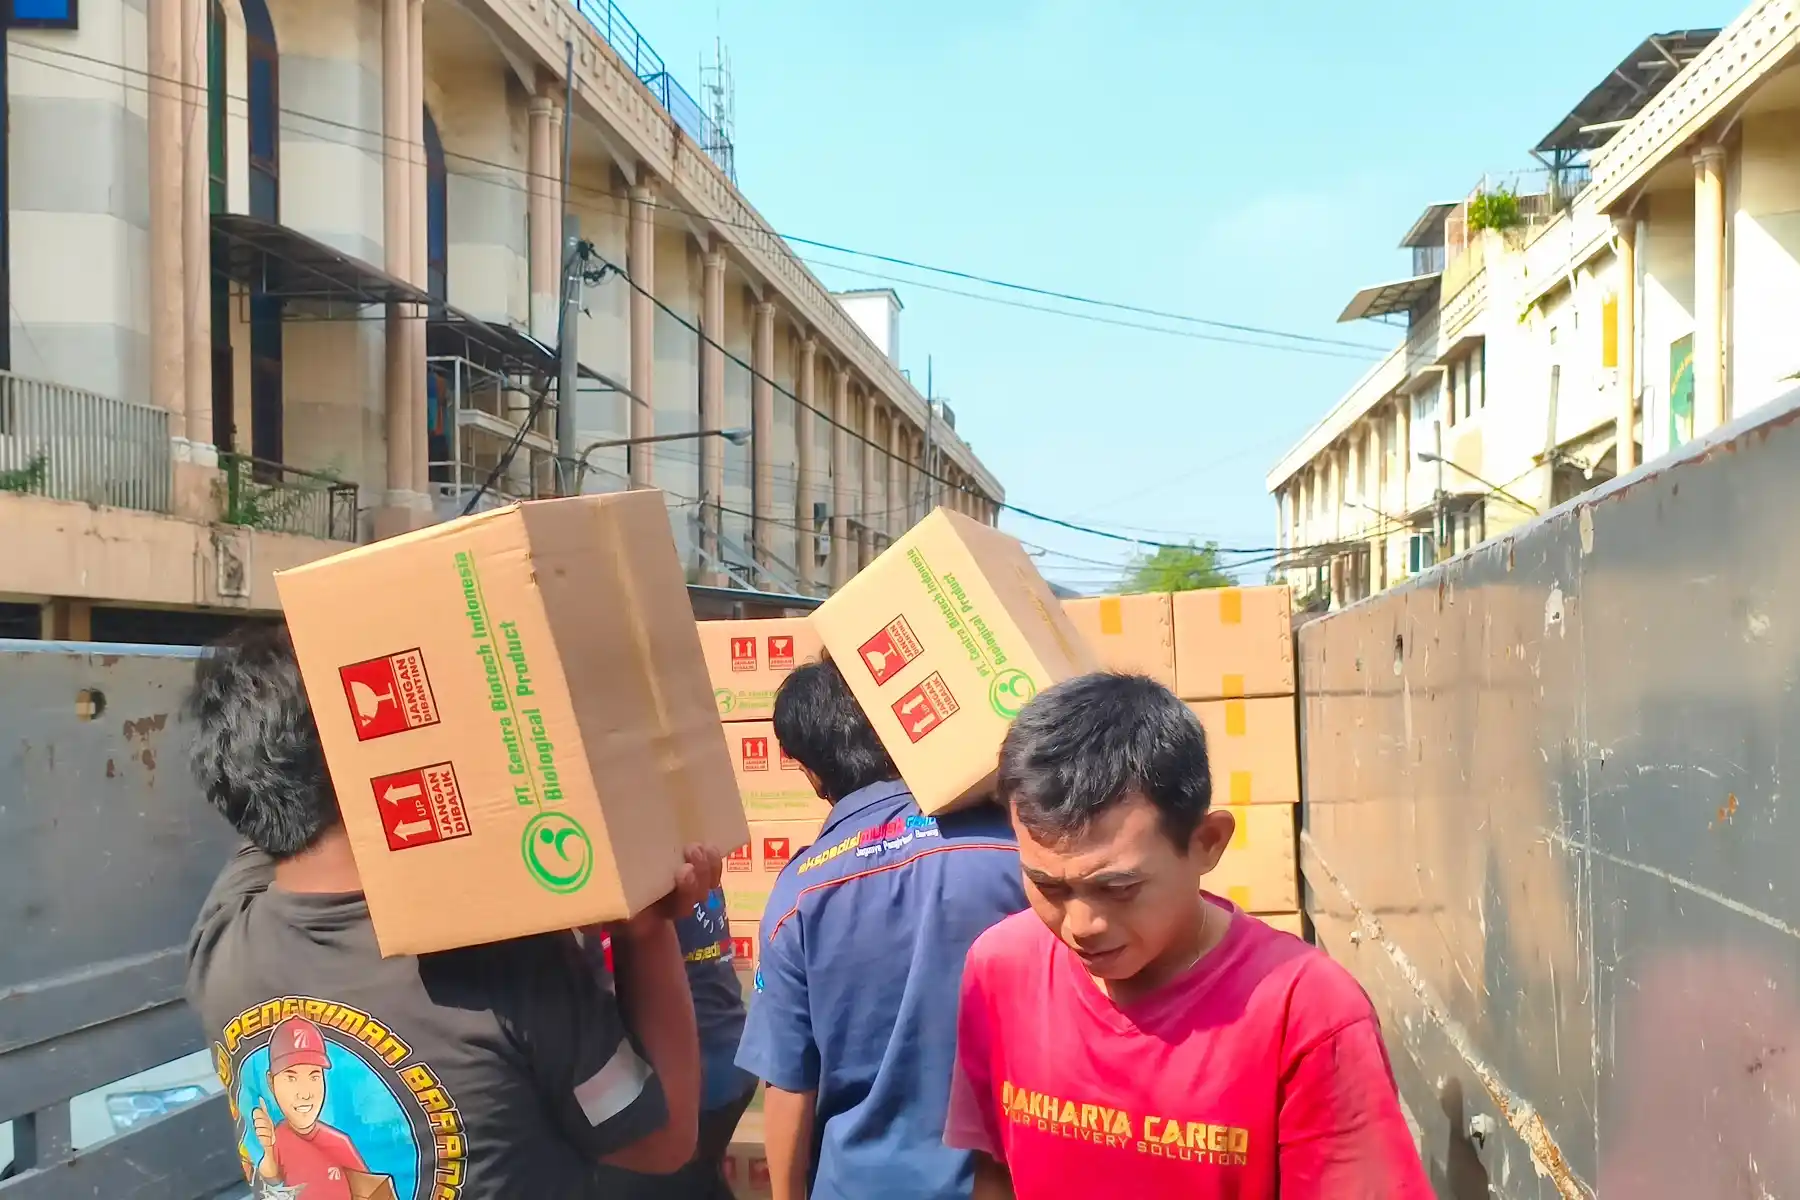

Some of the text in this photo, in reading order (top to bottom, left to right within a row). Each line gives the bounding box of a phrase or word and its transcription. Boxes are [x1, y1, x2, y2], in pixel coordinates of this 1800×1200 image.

[906, 549, 937, 594] Indonesia
[932, 592, 960, 629] Biotech
[943, 572, 1008, 665] Biological Product
[890, 625, 914, 658] JANGAN
[957, 629, 980, 660] Centra
[396, 659, 423, 723] JANGAN
[408, 656, 433, 722] DIBANTING
[454, 552, 534, 806] PT. Centra Biotech Indonesia
[925, 682, 949, 715] JANGAN
[932, 677, 956, 711] DIBALIK
[500, 620, 563, 801] Biological Product
[416, 800, 427, 817] UP
[428, 772, 453, 834] JANGAN
[441, 771, 466, 832] DIBALIK
[225, 998, 410, 1066] PENGIRIMAN
[1002, 1106, 1248, 1166] YUR DELIVERY SOLUTION
[1143, 1115, 1249, 1153] CARGO
